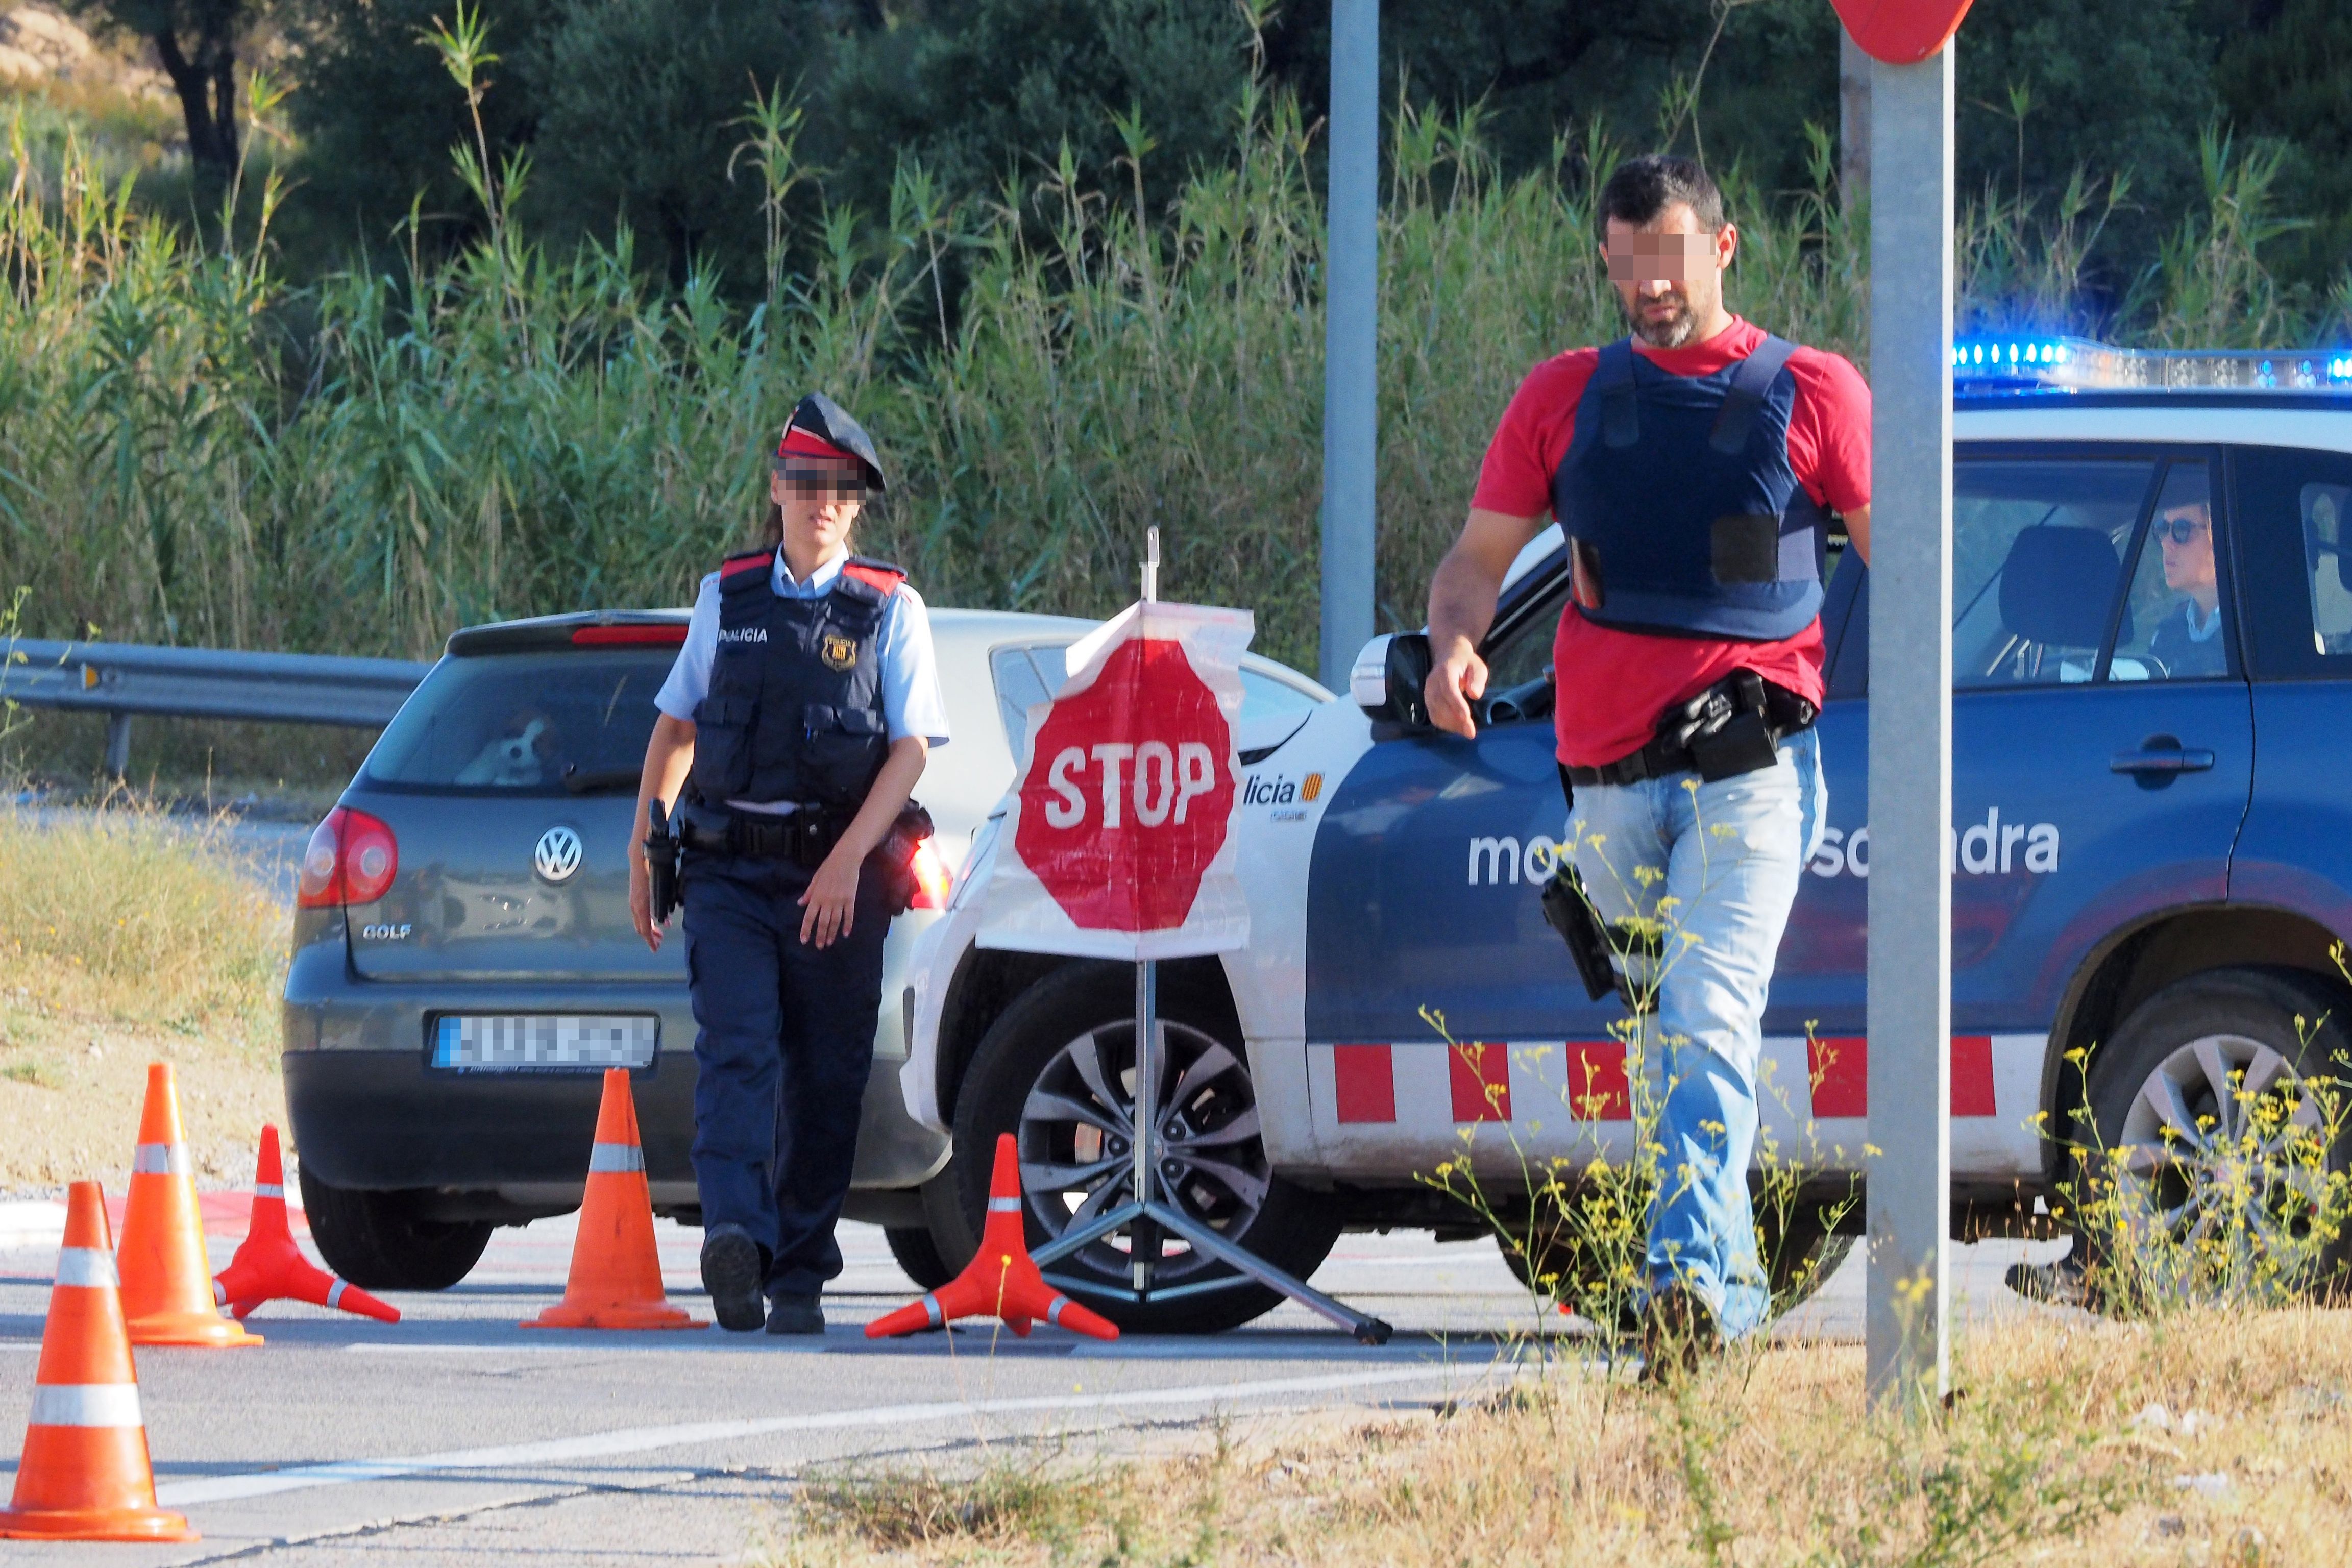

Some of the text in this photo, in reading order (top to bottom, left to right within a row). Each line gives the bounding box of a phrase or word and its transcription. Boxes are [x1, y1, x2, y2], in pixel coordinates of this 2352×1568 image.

[718, 628, 768, 643] POLICIA
[1045, 740, 1215, 829] STOP
[1243, 773, 1296, 805] licia
[363, 923, 412, 939] GOLF
